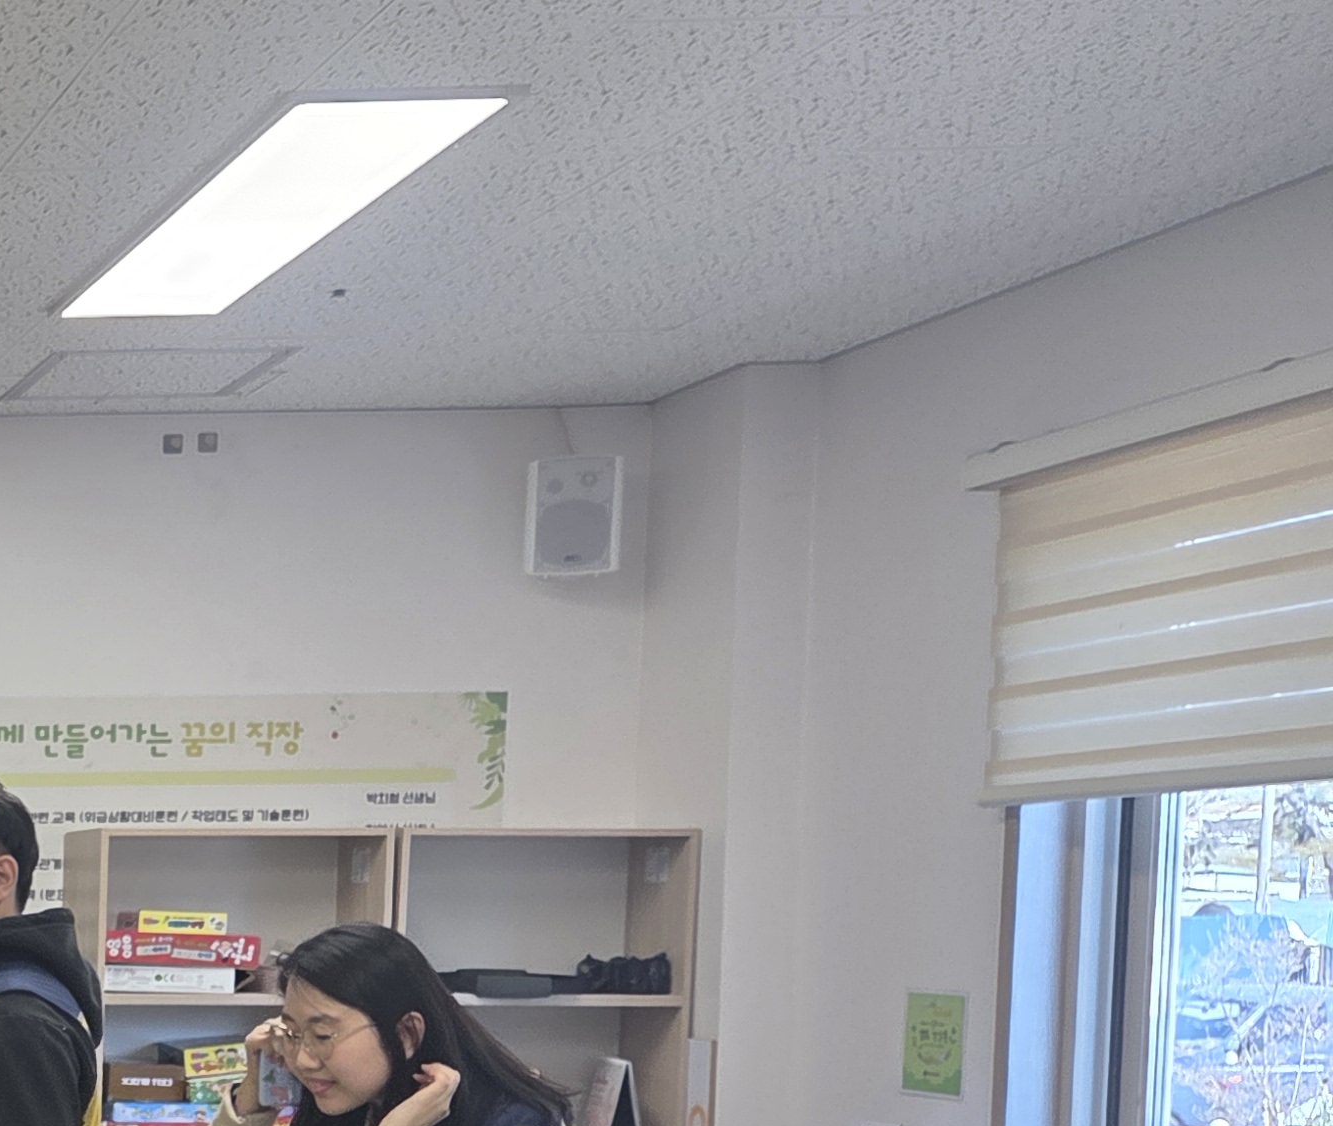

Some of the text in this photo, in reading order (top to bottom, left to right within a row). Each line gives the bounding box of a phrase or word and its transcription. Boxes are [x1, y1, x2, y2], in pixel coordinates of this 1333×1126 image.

[34, 724, 173, 759] 만들어가는
[181, 722, 236, 758] 꿈의
[246, 722, 305, 756] 직장
[402, 791, 436, 805] 선생님
[51, 811, 76, 825] 교육
[191, 810, 238, 823] 작업태도
[241, 810, 254, 822] 및
[257, 808, 310, 822] 기술훈련)
